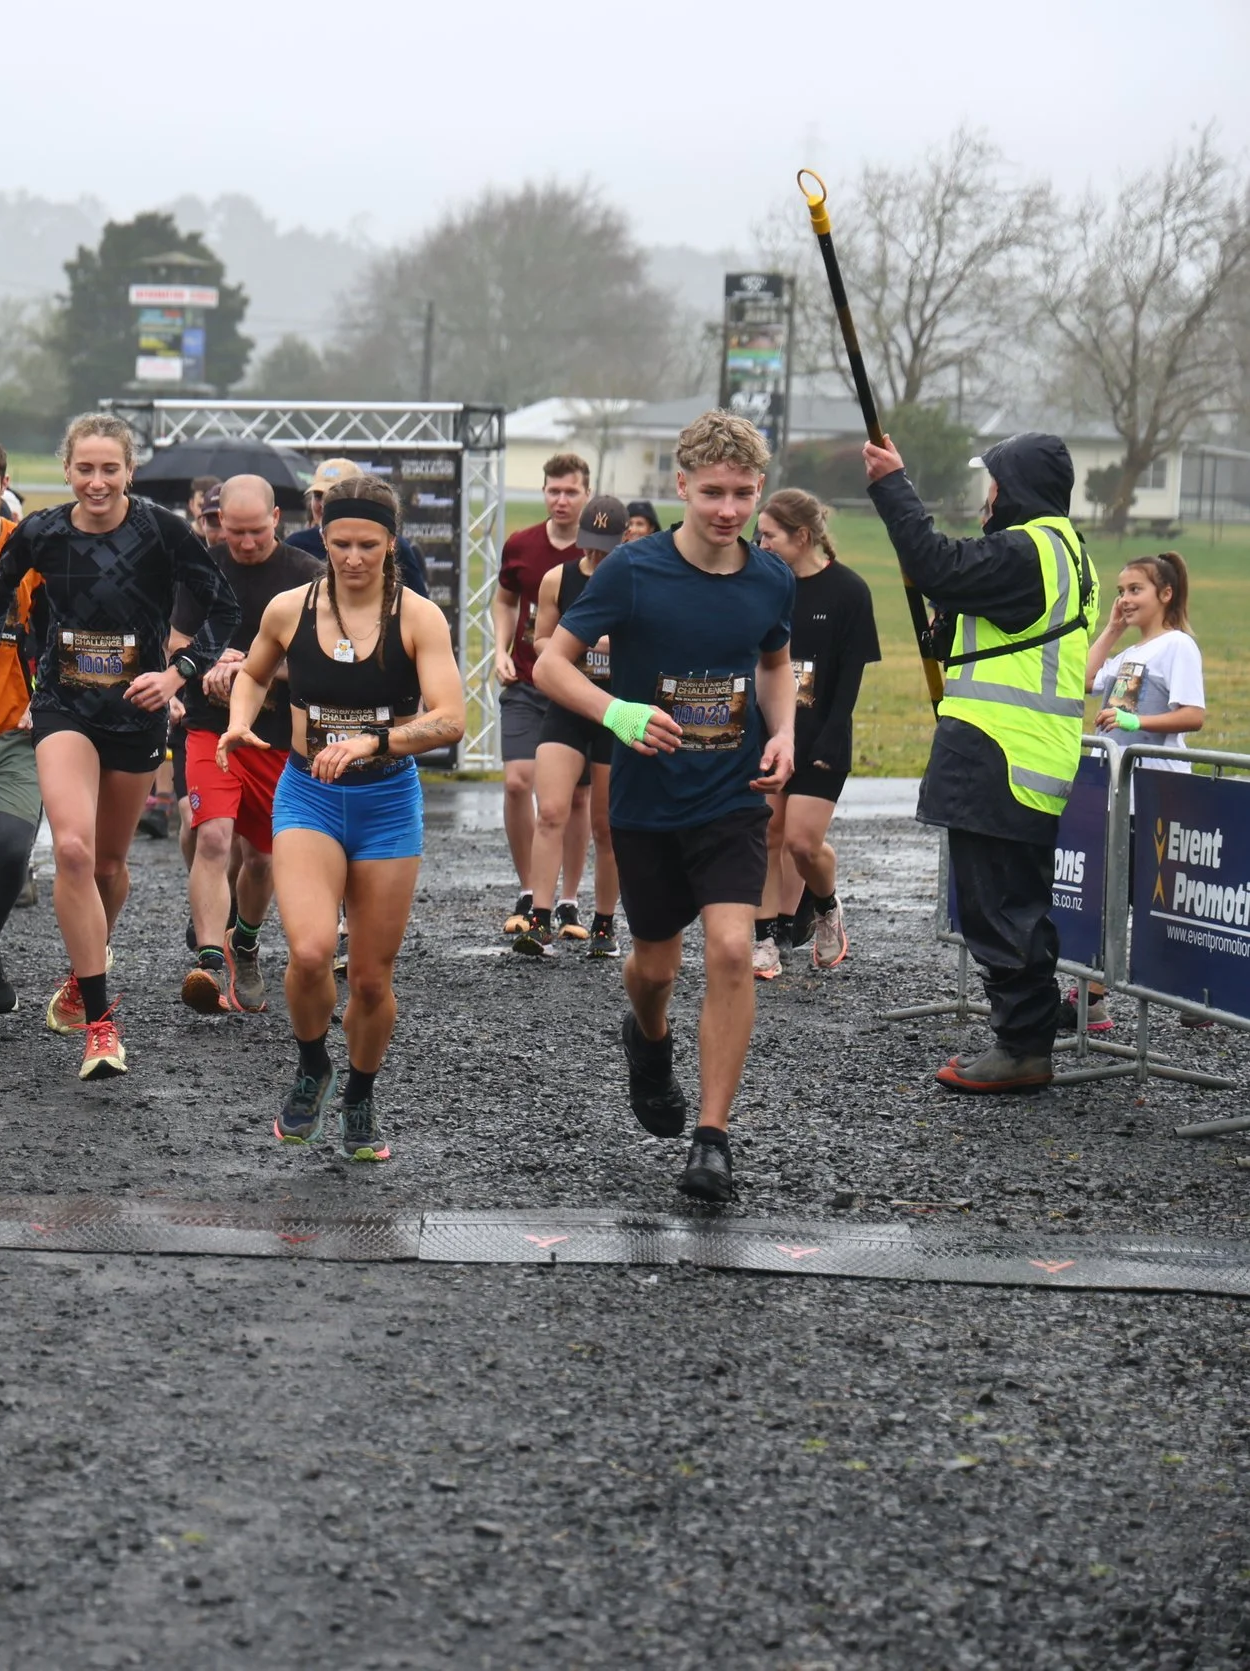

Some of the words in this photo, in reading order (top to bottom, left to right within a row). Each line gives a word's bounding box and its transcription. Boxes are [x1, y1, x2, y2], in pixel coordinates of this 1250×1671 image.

[76, 654, 122, 676] 10015
[678, 686, 732, 695] CHALLENGE
[321, 713, 374, 721] CHALLENGE
[672, 704, 730, 727] 10020
[1168, 821, 1223, 869] Event
